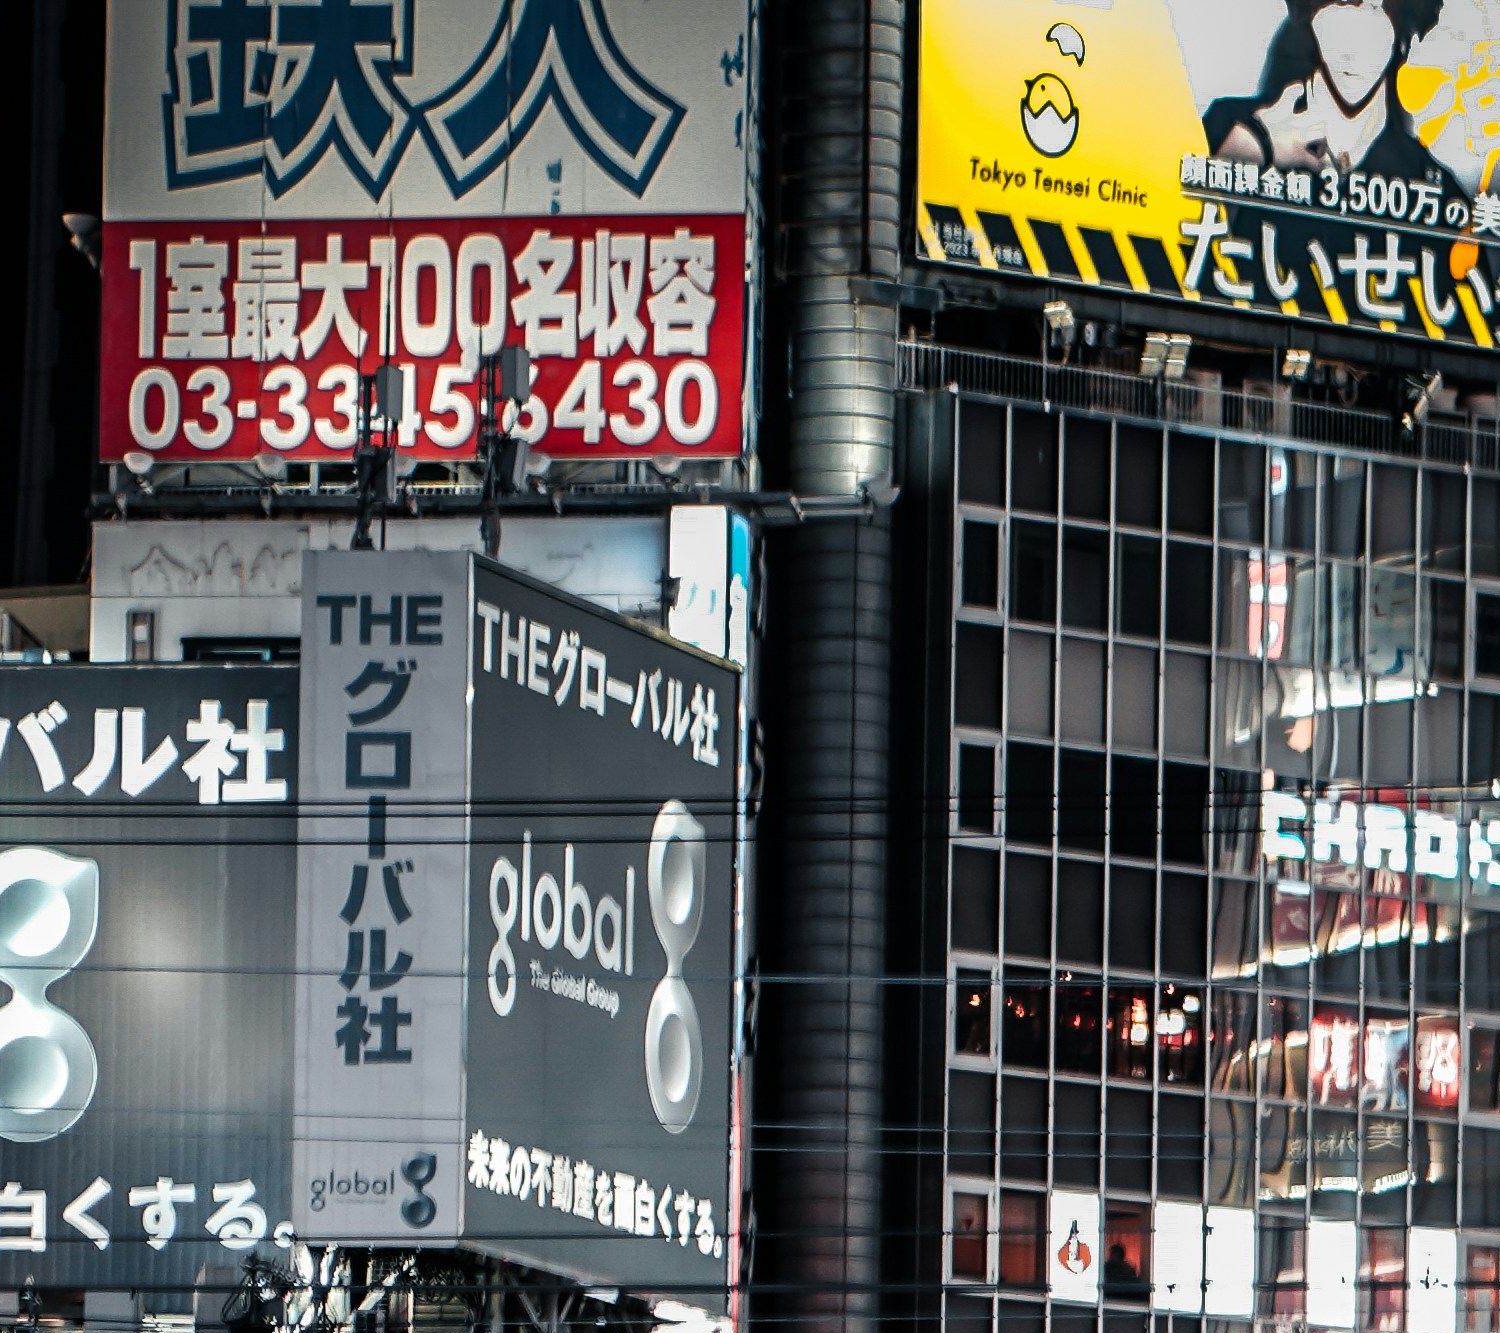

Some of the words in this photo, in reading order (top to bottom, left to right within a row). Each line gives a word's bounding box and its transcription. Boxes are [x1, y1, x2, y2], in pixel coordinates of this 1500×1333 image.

[970, 156, 1026, 191] Tokyo
[1032, 166, 1090, 198] Tensei
[1097, 179, 1148, 208] Clinic
[128, 226, 718, 362] 1室最大100名収容
[316, 595, 443, 646] THE
[487, 829, 635, 1018] global
[309, 1166, 396, 1213] global
